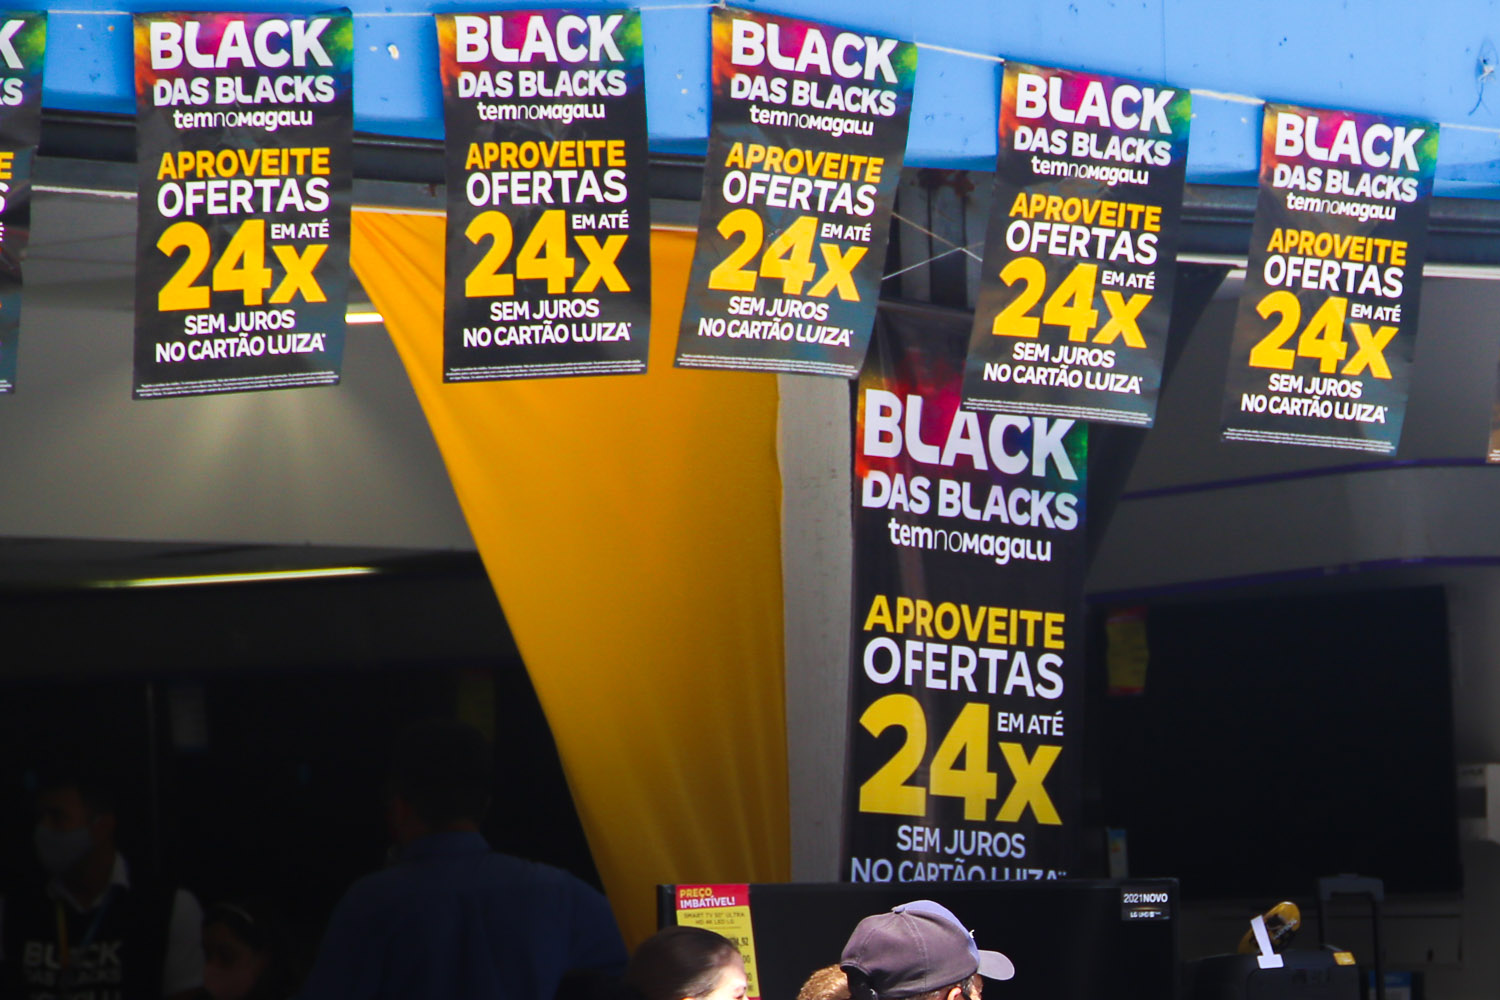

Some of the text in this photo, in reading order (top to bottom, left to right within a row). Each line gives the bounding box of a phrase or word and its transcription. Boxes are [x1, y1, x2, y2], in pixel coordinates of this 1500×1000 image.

[150, 18, 333, 70] BLACK
[454, 14, 624, 63] BLACK
[153, 75, 335, 107] DAS BLACKS
[457, 69, 627, 98] DAS BLACKS
[1015, 72, 1175, 135] BLACK
[465, 139, 627, 170] APROVEITE
[1013, 125, 1172, 166] DAS BLACKS
[1274, 112, 1425, 172] BLACK
[157, 147, 330, 180] APROVEITE
[157, 177, 329, 218] OFERTAS
[466, 169, 627, 206] OFERTAS
[1272, 163, 1419, 203] DAS BLACKS
[572, 209, 630, 229] EM ATÉ
[1009, 192, 1162, 232] APROVEITE
[271, 218, 330, 239] EM ATÉ
[1006, 219, 1158, 265] OFERTAS
[1267, 228, 1408, 266] APROVEITE
[1101, 270, 1156, 290] EM ATÉ
[1264, 254, 1404, 298] OFERTAS
[184, 309, 296, 338] SEM JUROS
[490, 298, 600, 325] SEM JUROS
[1350, 303, 1402, 323] EM ATÉ
[156, 341, 186, 363] NO
[188, 332, 265, 360] CARTÃO
[463, 327, 492, 348] NO
[494, 319, 569, 346] CARTÃO
[1012, 342, 1116, 369] SEM JUROS
[983, 362, 1012, 382] NO
[1012, 364, 1083, 388] CARTÃO
[1268, 373, 1363, 399] SEM JUROS
[1241, 393, 1268, 413] NO
[1268, 395, 1333, 418] CARTÃO
[864, 388, 1079, 481] BLACK
[861, 471, 1079, 531] DAS BLACKS
[863, 594, 1066, 650] APROVEITE
[863, 637, 1065, 700] OFERTAS
[997, 709, 1064, 736] EM ATÉ
[896, 825, 1026, 859] SEM JUROS
[851, 857, 893, 882] NO
[679, 888, 713, 899] PREÇO
[680, 896, 736, 909] IMBATÍVEL!
